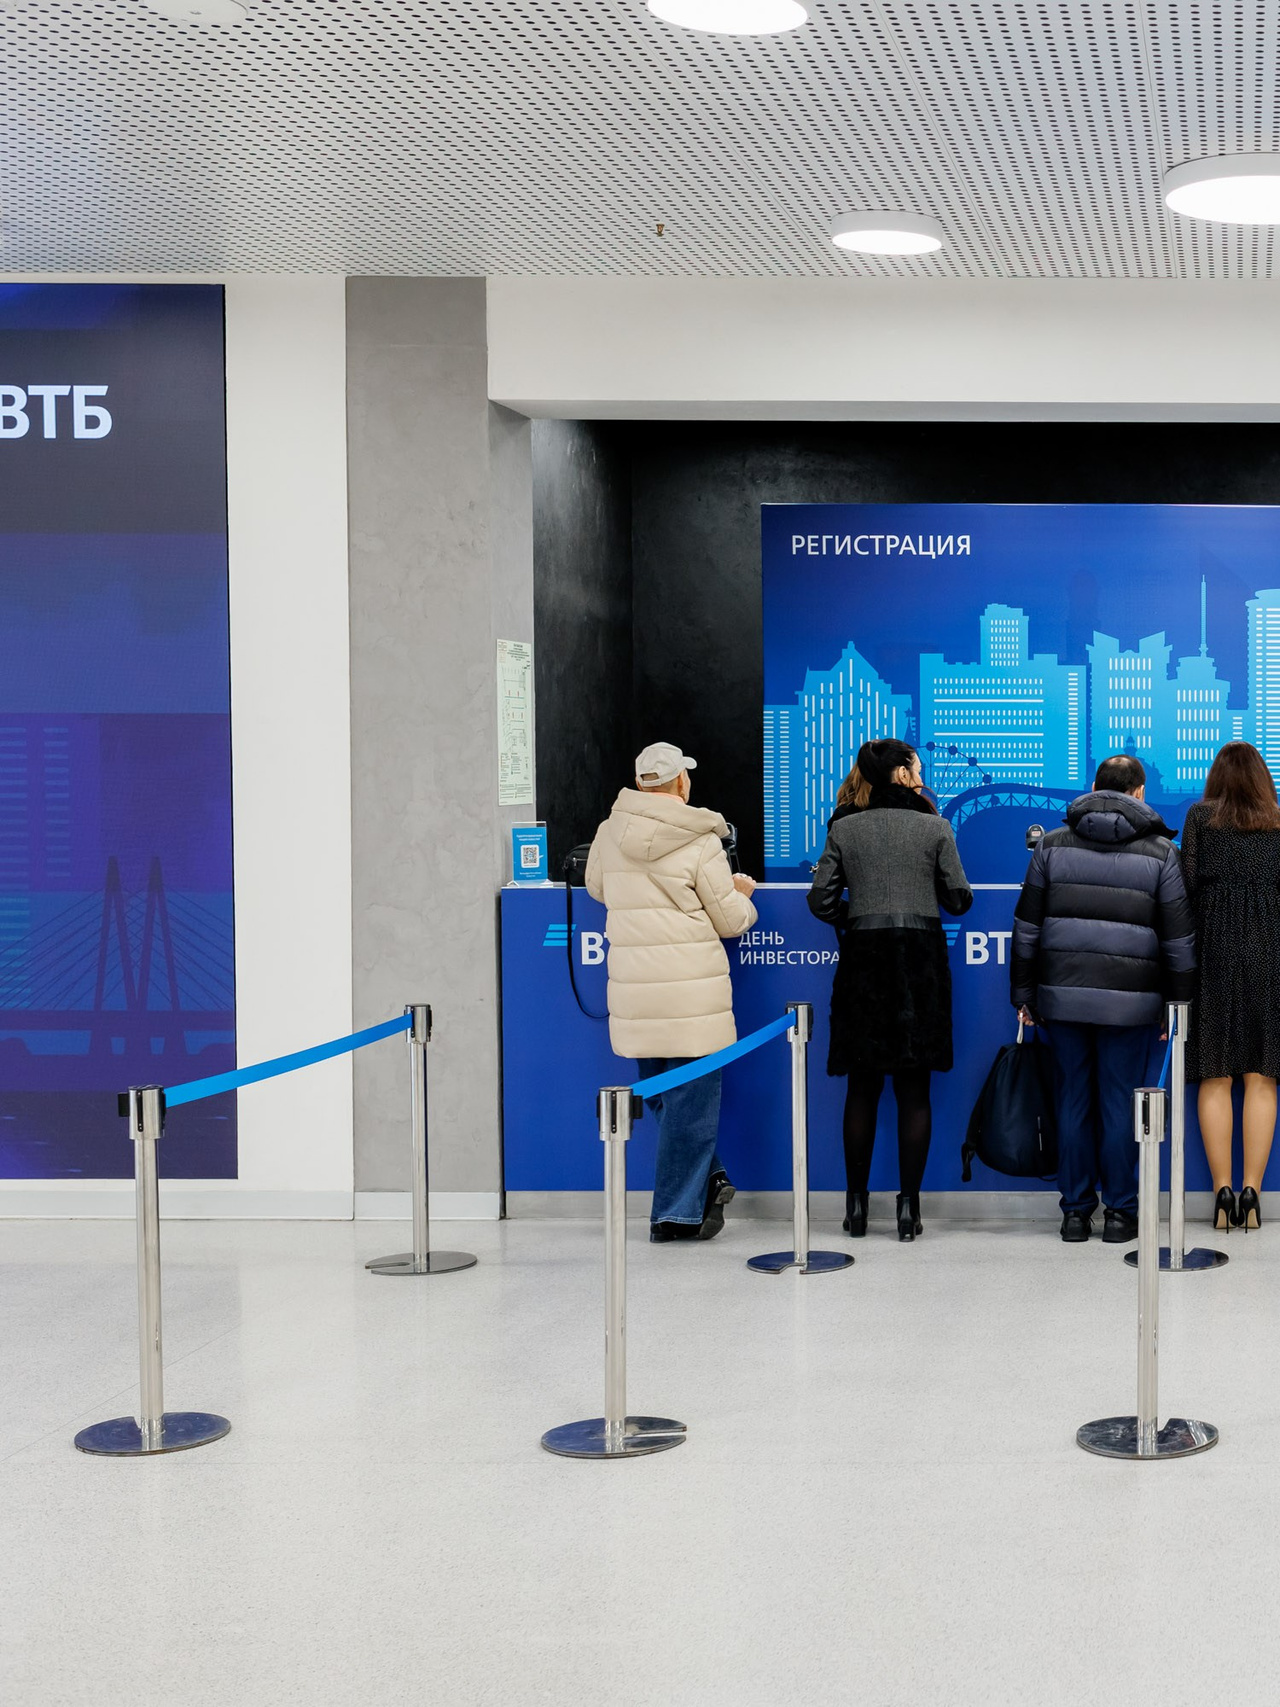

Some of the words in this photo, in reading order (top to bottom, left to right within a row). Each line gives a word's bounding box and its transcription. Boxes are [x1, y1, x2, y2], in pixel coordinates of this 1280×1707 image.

[0, 384, 113, 439] ВТБ
[791, 534, 971, 559] РЕГИСТРАЦИЯ
[739, 932, 785, 947] ДЕНЬ
[966, 931, 1013, 965] ВТ
[740, 951, 839, 965] ИНВЕСТОРА
